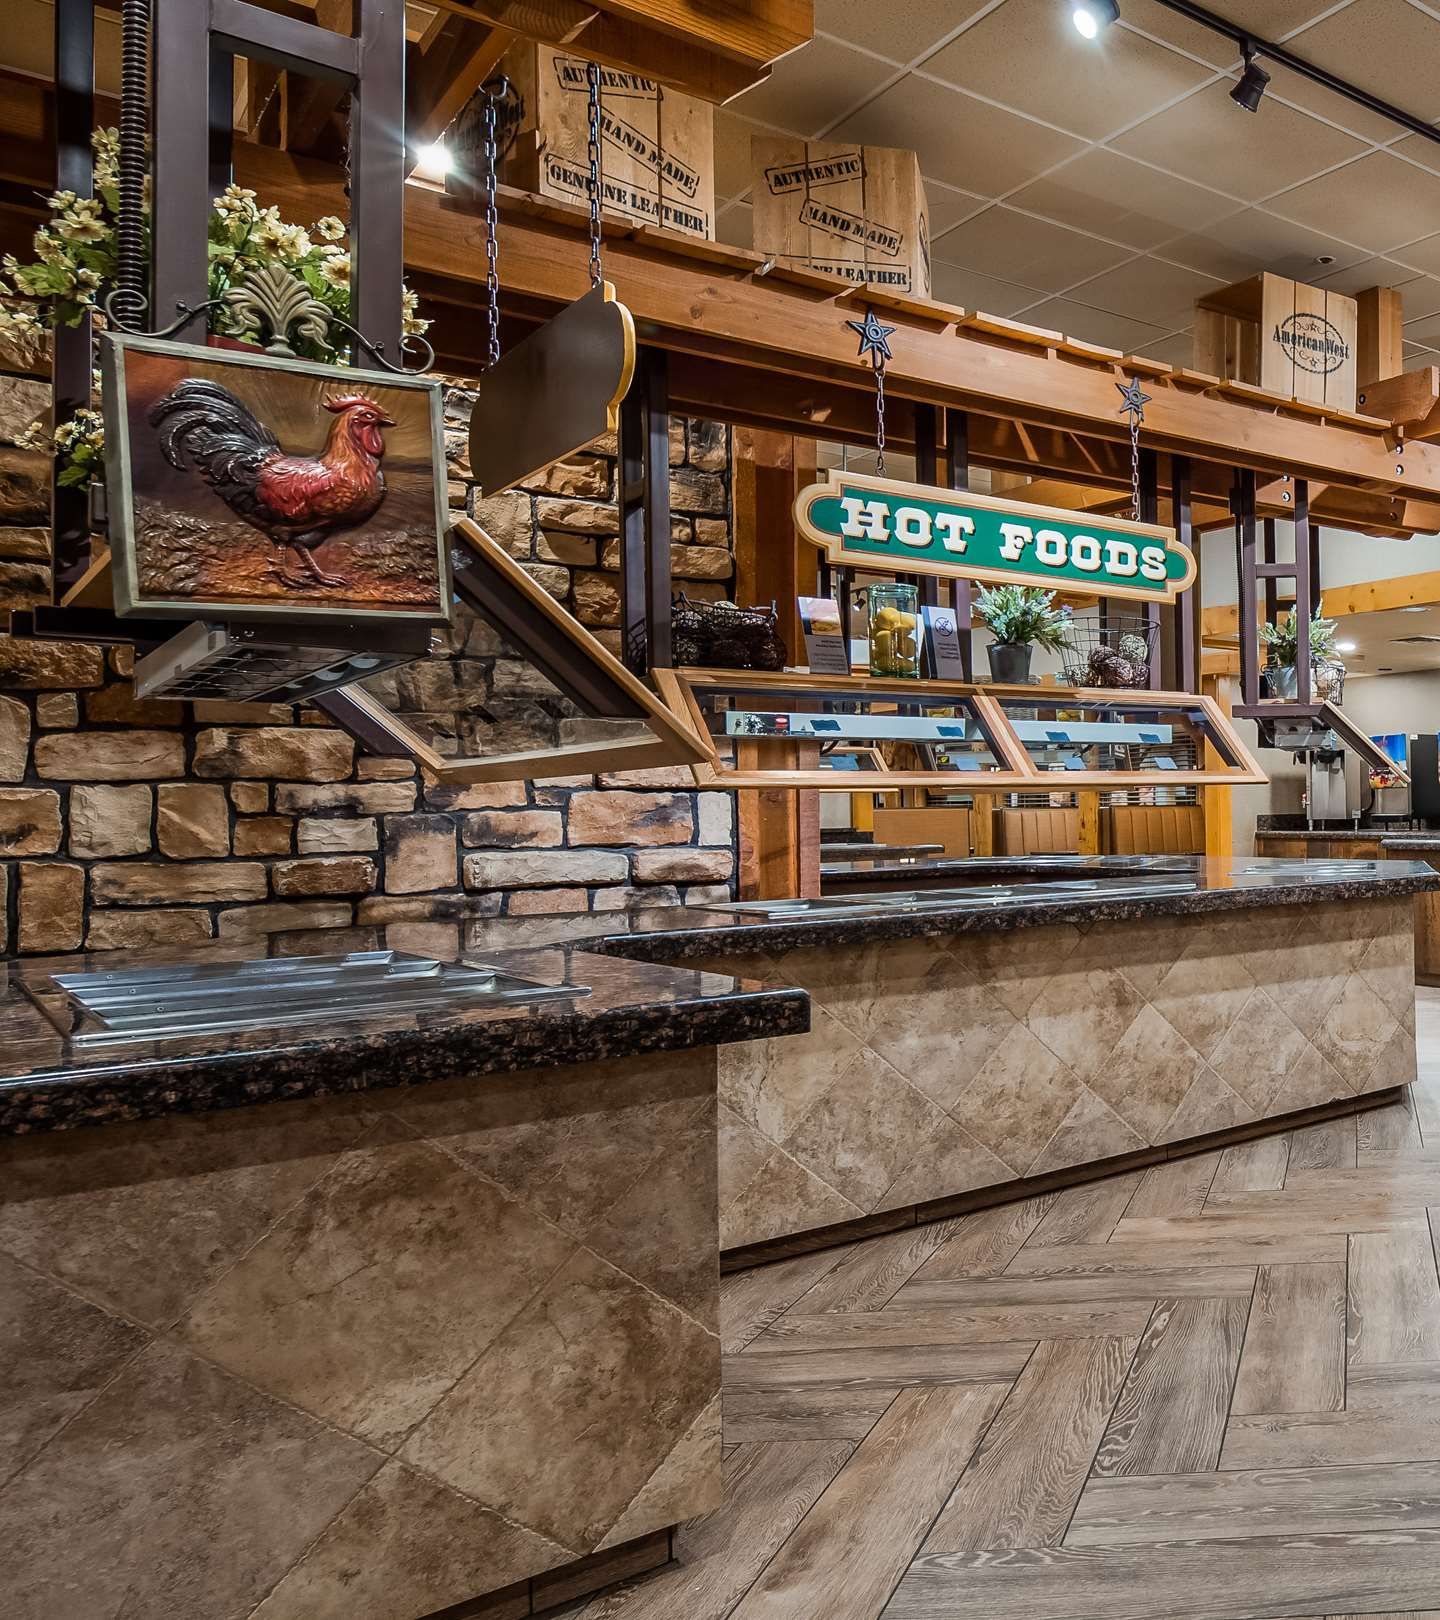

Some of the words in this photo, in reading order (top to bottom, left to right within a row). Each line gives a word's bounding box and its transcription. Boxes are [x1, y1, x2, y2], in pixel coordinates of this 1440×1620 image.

[563, 66, 656, 92] AUHENTIC
[600, 114, 646, 156] HAND
[648, 149, 696, 190] MADE
[773, 159, 860, 187] AUTHENTIC
[550, 164, 627, 205] GENUNE
[631, 191, 704, 232] LEATHER
[806, 206, 850, 232] HAND
[852, 225, 898, 250] MADE
[839, 497, 976, 554] HOT
[998, 522, 1169, 583] FOODS
